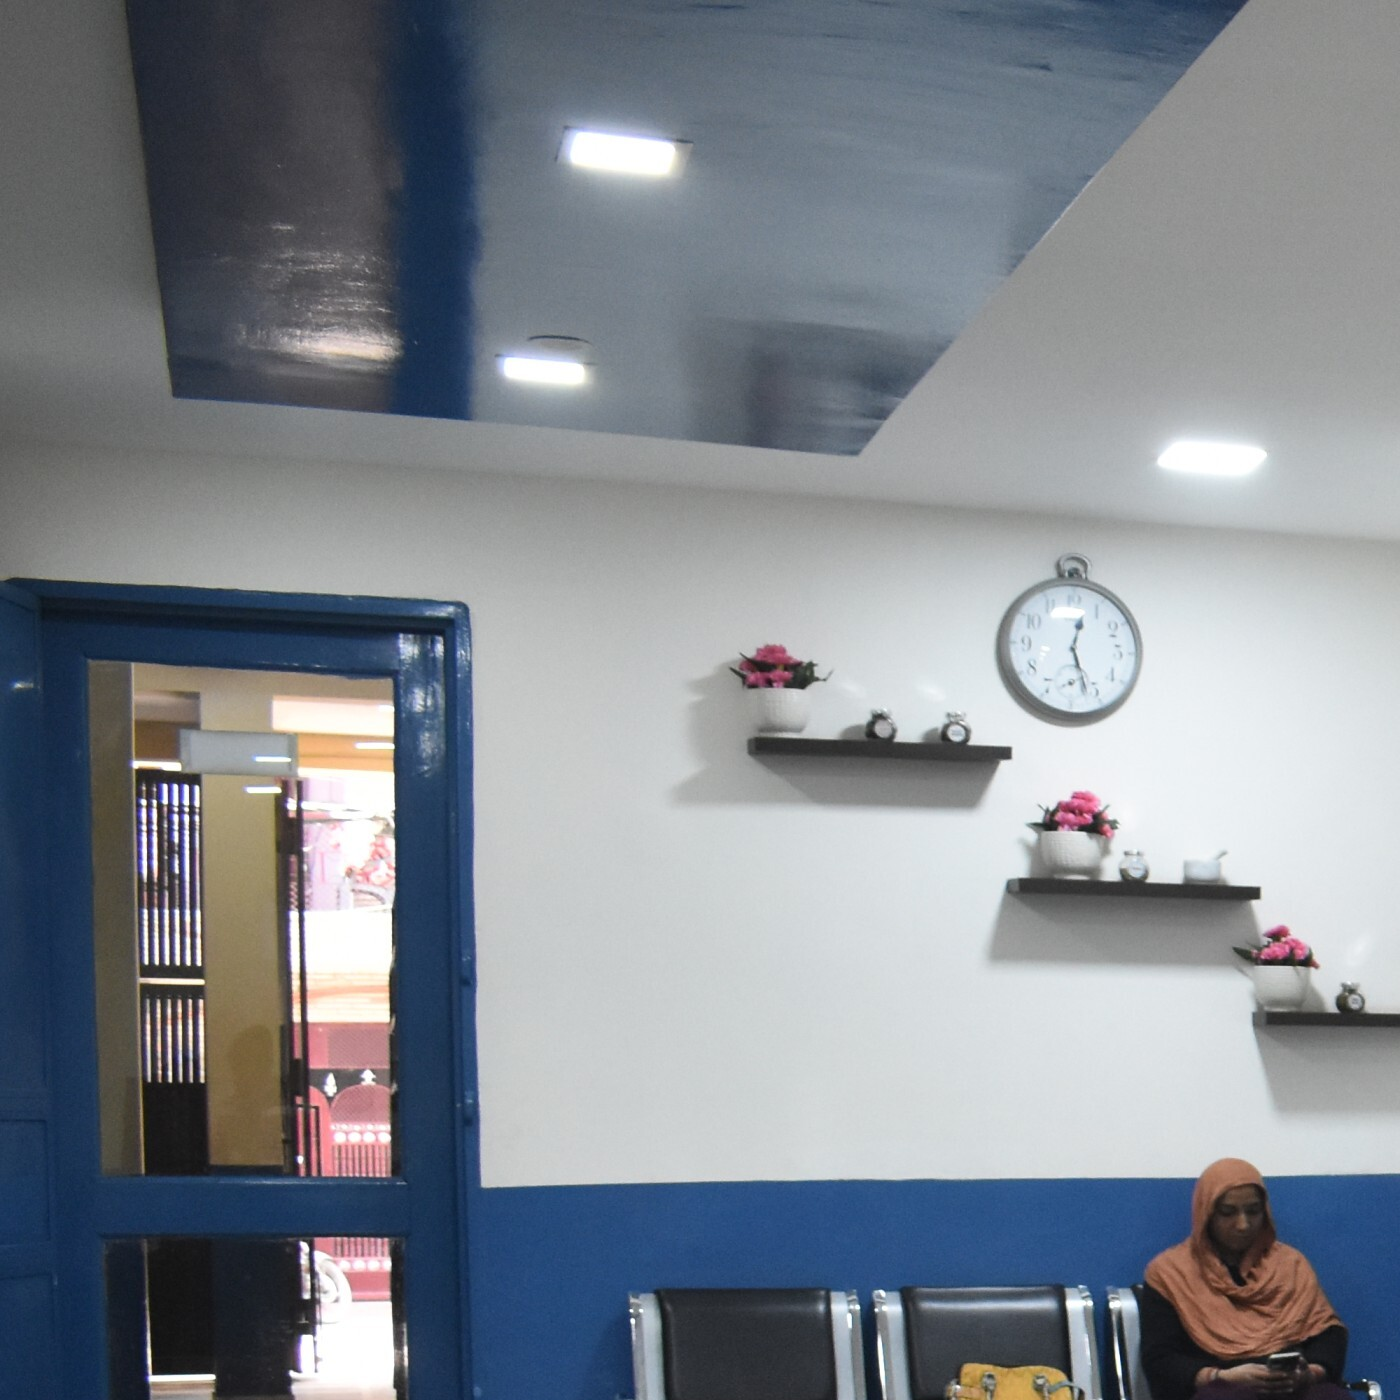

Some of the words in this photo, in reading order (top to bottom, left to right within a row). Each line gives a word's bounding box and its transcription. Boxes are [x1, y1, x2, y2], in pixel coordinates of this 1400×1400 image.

[1026, 613, 1041, 630] 10
[1021, 635, 1032, 651] 9
[1027, 659, 1037, 675] 8
